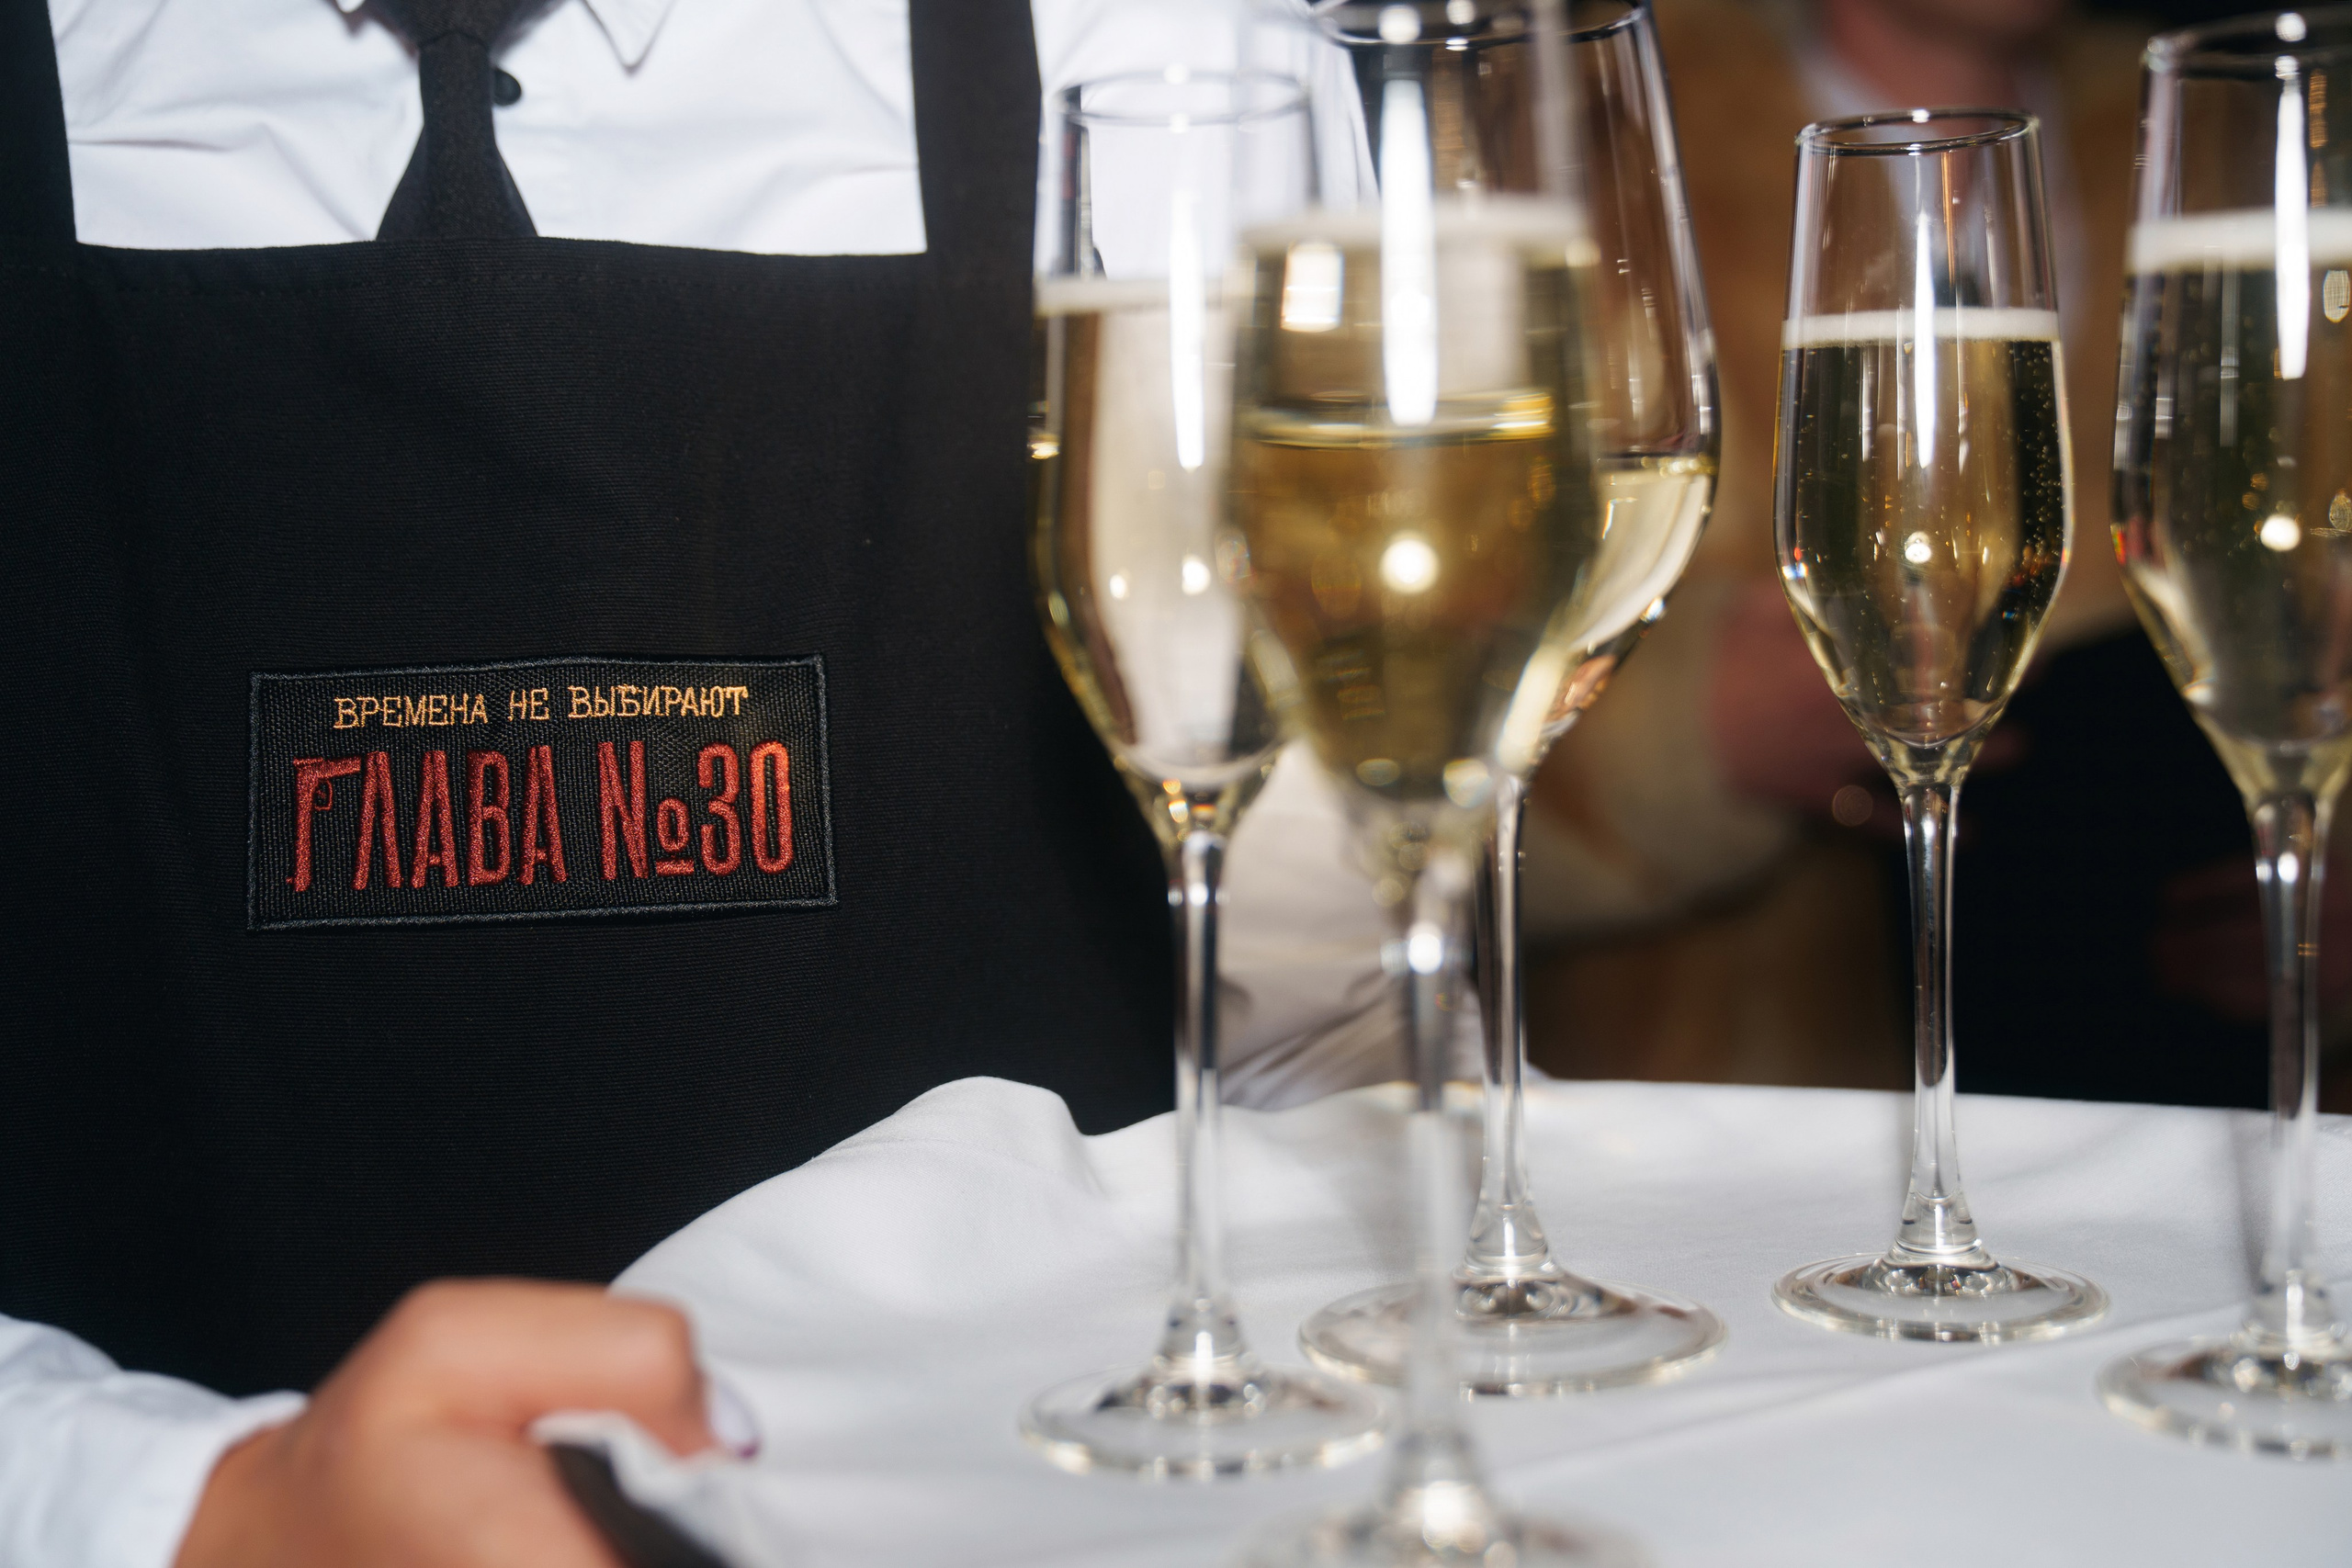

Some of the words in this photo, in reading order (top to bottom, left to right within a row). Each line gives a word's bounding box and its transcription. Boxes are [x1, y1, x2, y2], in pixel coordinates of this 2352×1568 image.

[333, 694, 489, 729] ВРЕМЕНА
[508, 688, 549, 722] НЕ
[567, 683, 749, 720] ВЫБИРАЮТ
[285, 744, 569, 893] ГЛАВА
